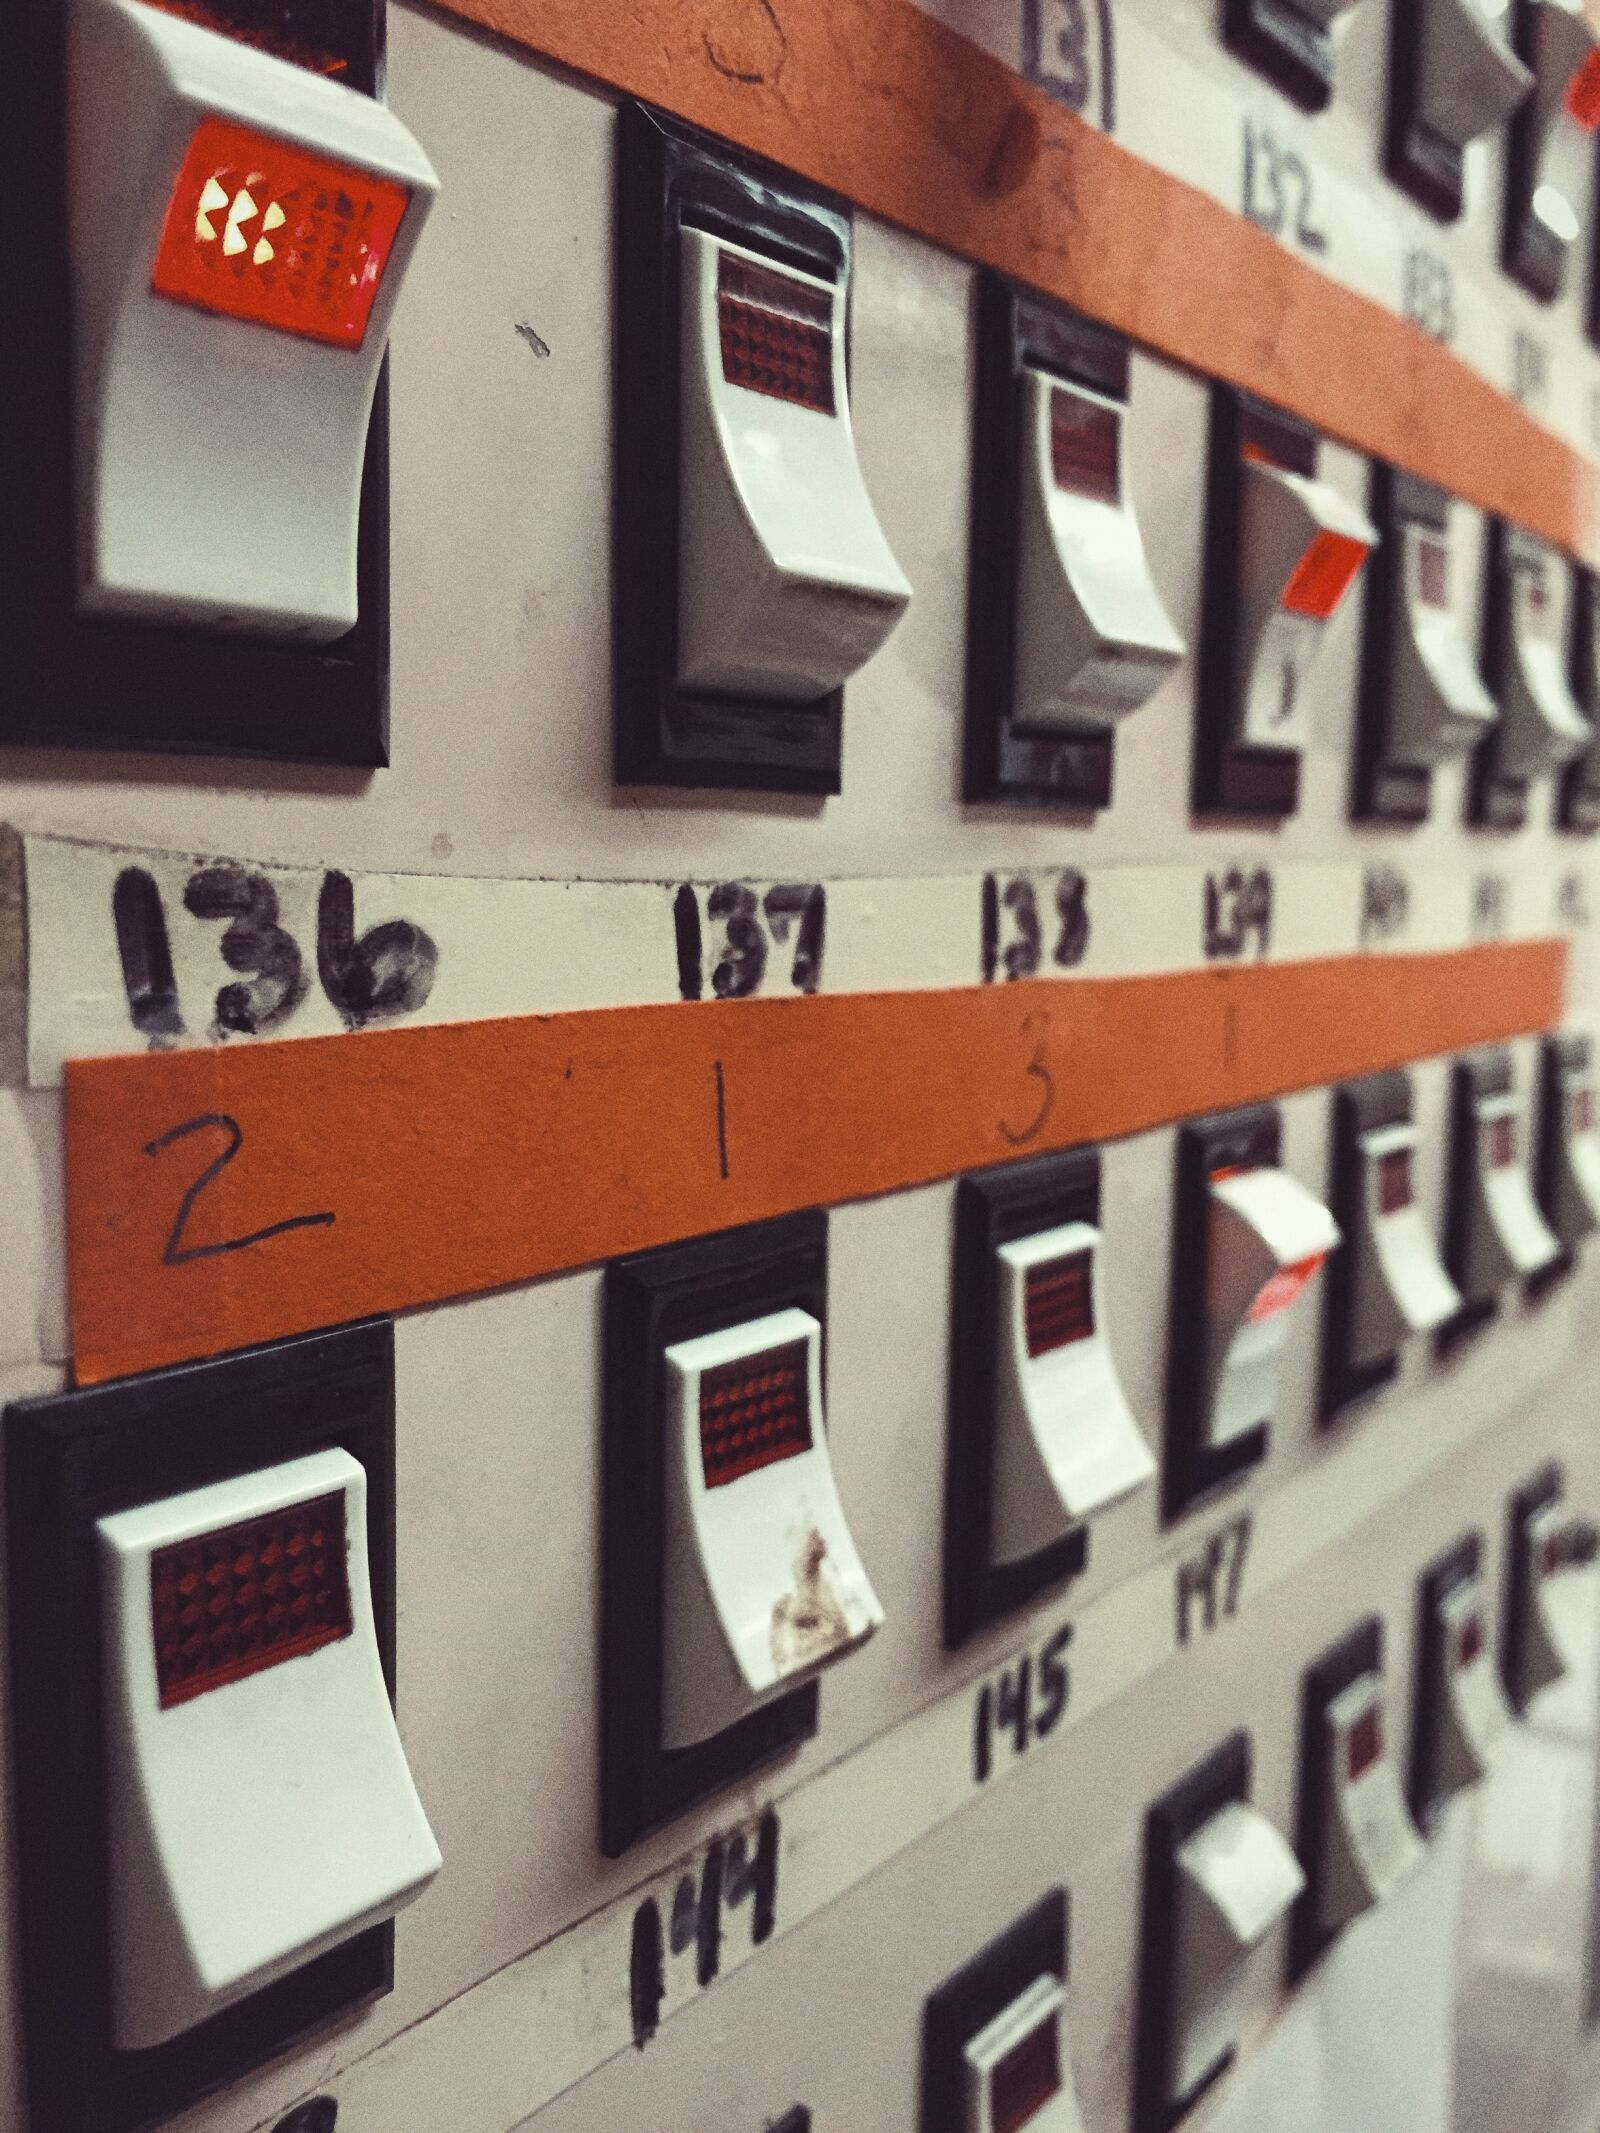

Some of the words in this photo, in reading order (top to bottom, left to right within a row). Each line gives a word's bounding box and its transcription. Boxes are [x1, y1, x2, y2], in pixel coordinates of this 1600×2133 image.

[113, 866, 438, 1050] 136
[674, 881, 826, 1000] 137
[145, 1112, 336, 1267] 2
[713, 1059, 730, 1181] 1
[629, 1804, 780, 2050] 144
[973, 1622, 1074, 1783] 145
